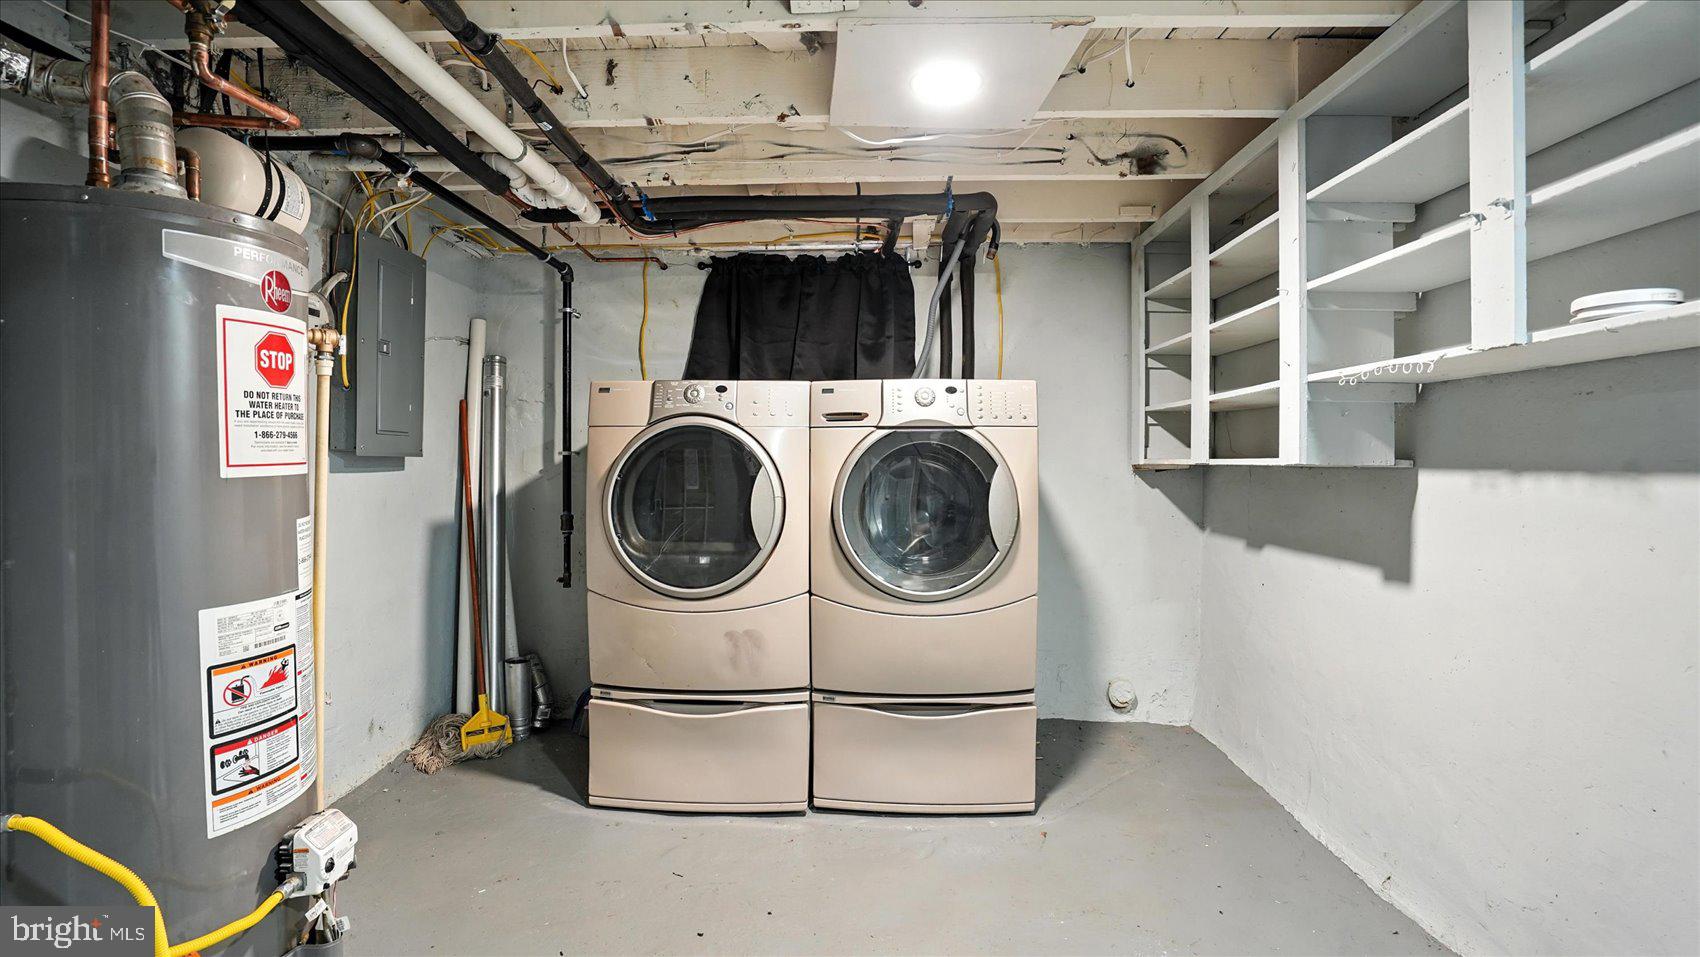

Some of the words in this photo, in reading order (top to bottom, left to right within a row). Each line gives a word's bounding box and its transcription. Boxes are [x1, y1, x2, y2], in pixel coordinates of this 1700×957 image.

[264, 270, 290, 306] Rheem
[260, 349, 293, 371] STOP
[243, 390, 254, 399] DO
[256, 391, 270, 399] NOT
[272, 392, 292, 401] RETURN
[293, 394, 301, 402] THIS
[249, 401, 273, 409] WATER
[274, 402, 294, 410] HEATER
[294, 403, 299, 411] TO
[235, 410, 251, 418] THE
[253, 410, 274, 419] PLACE
[275, 411, 283, 419] OF
[285, 412, 304, 421] PURCHASE
[248, 655, 278, 667] WARNING
[254, 729, 279, 742] DANGER
[256, 776, 281, 791] WARNING
